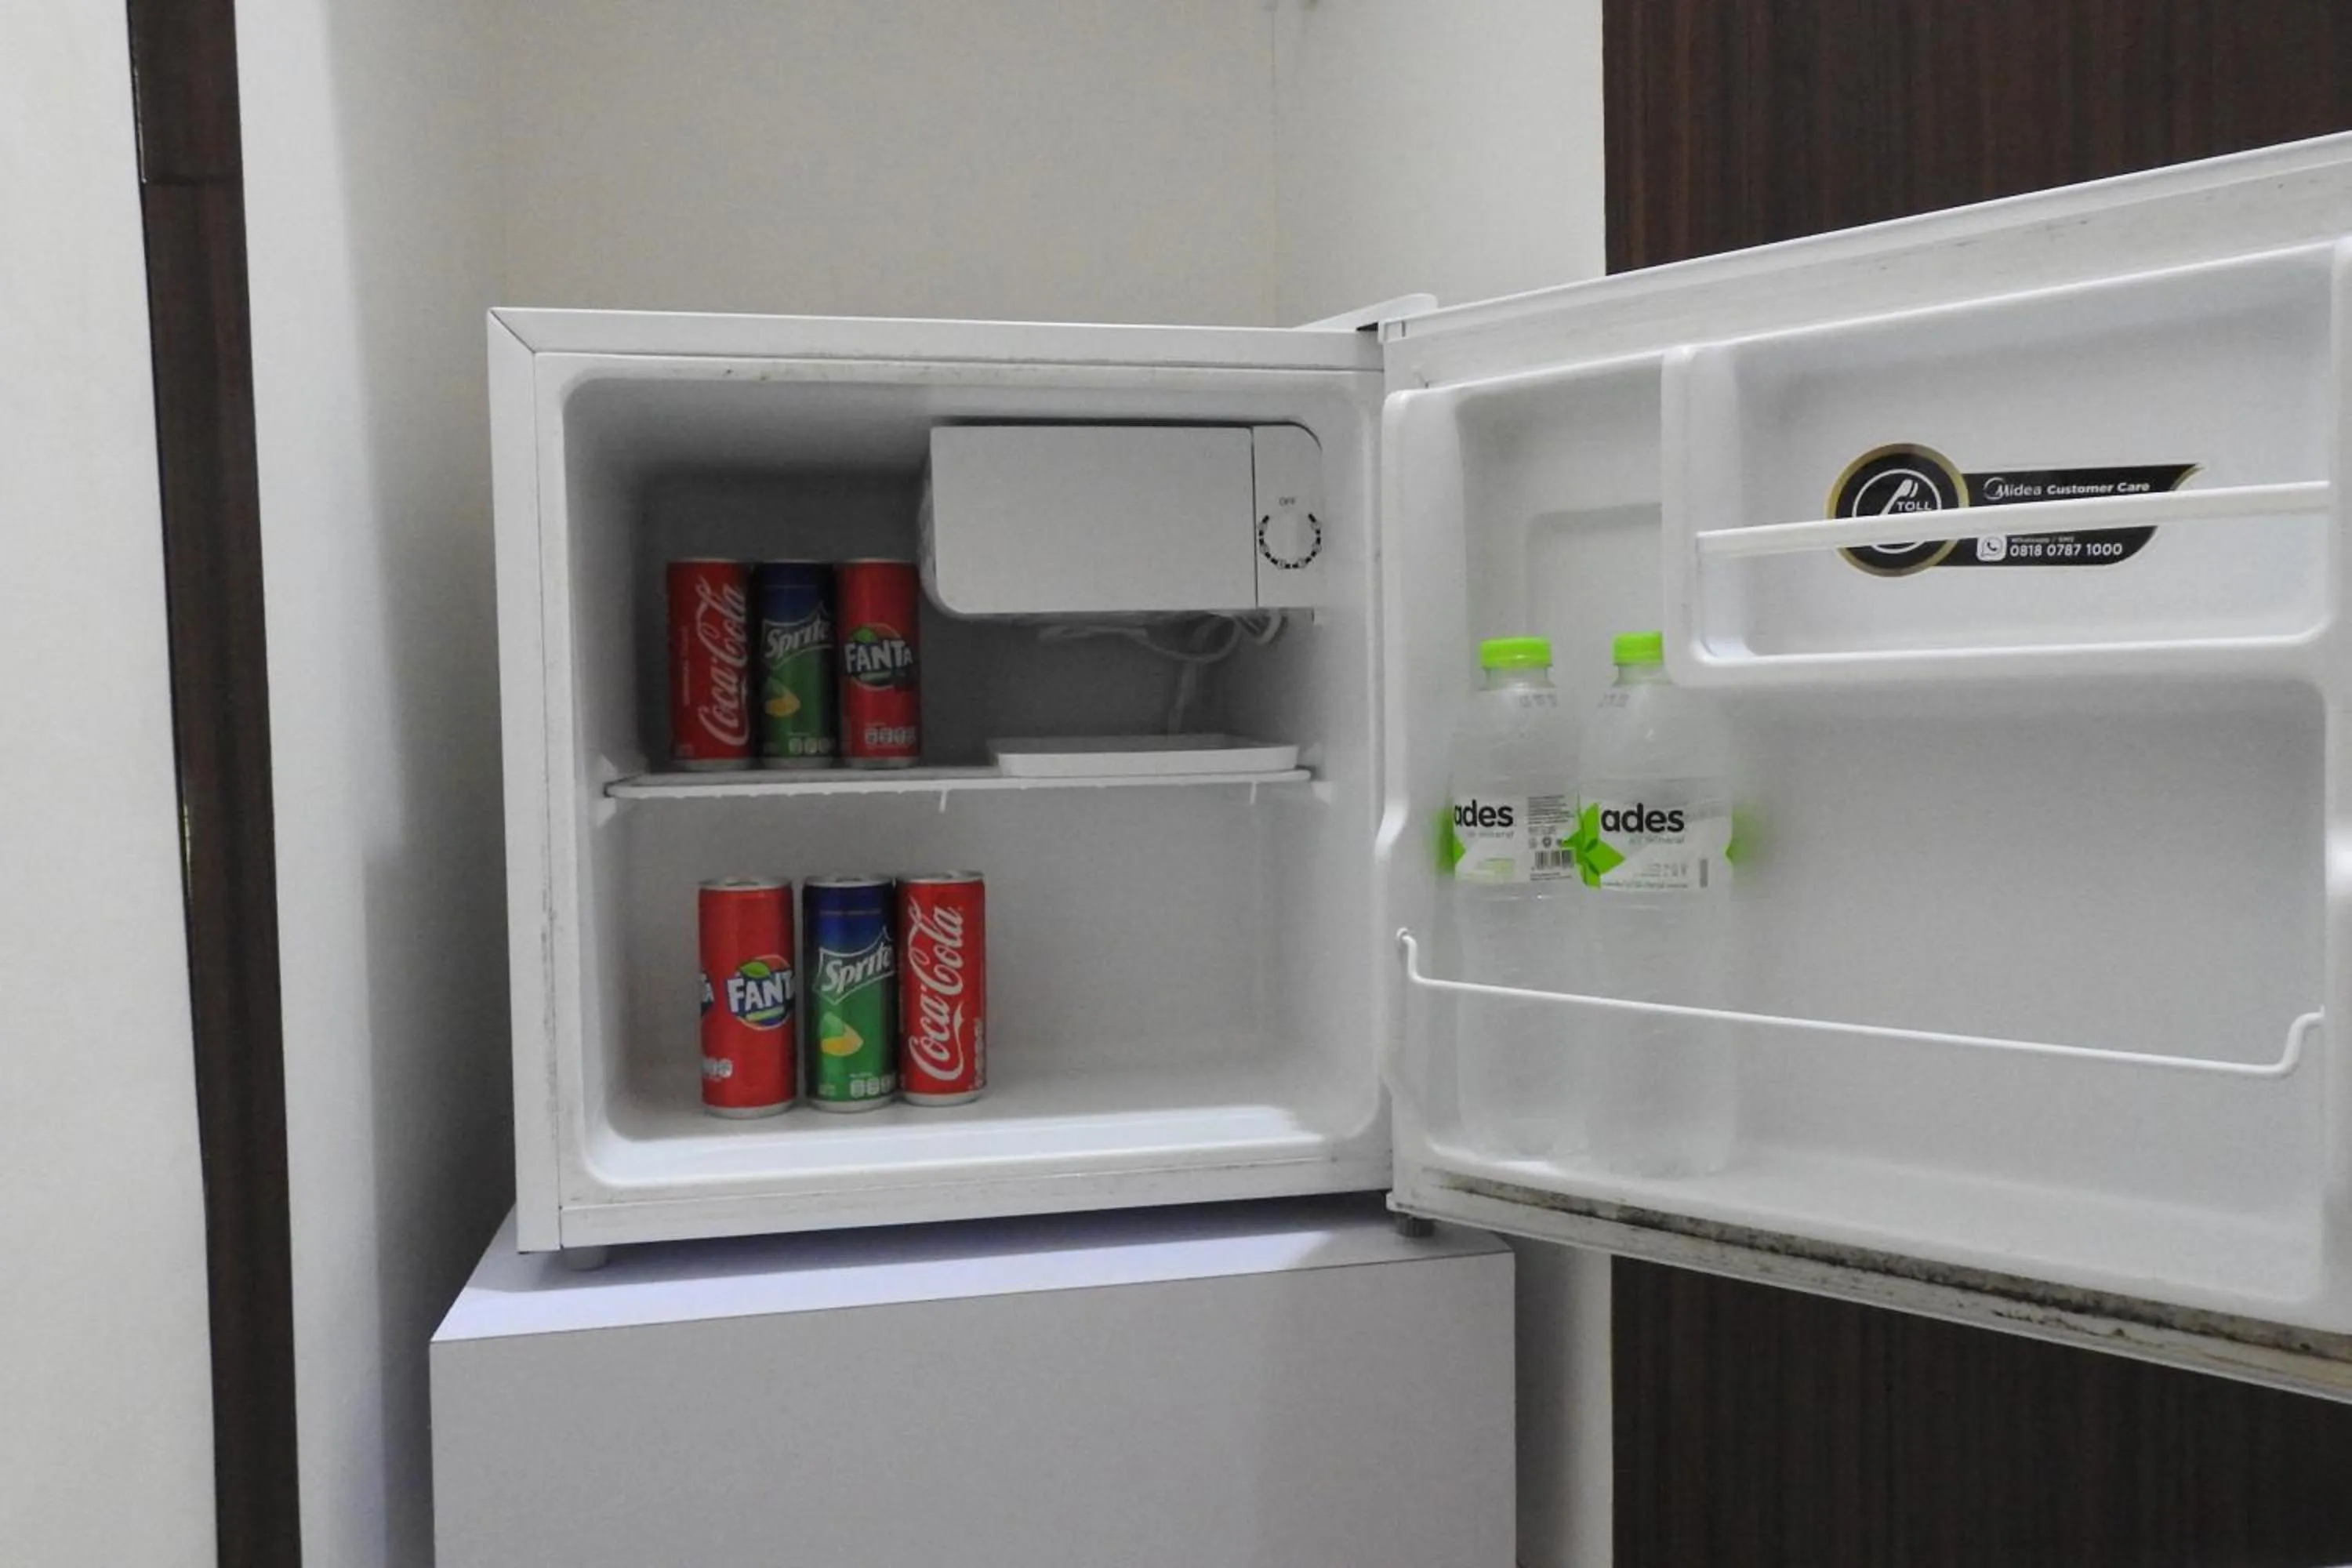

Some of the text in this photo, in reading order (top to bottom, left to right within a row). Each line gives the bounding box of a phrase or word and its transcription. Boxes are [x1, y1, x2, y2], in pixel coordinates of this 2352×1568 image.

[1990, 481, 2151, 498] Midea Customer Care
[1897, 501, 1933, 511] TOLL
[2009, 543, 2123, 557] 0818 0787 1000
[764, 613, 831, 659] Sprite
[844, 641, 913, 673] FANTA
[1454, 799, 1515, 828] ades
[1601, 803, 1685, 833] ades
[821, 942, 893, 994] Sprite
[727, 971, 793, 1013] FANT
[907, 895, 964, 1081] Coca-Cola
